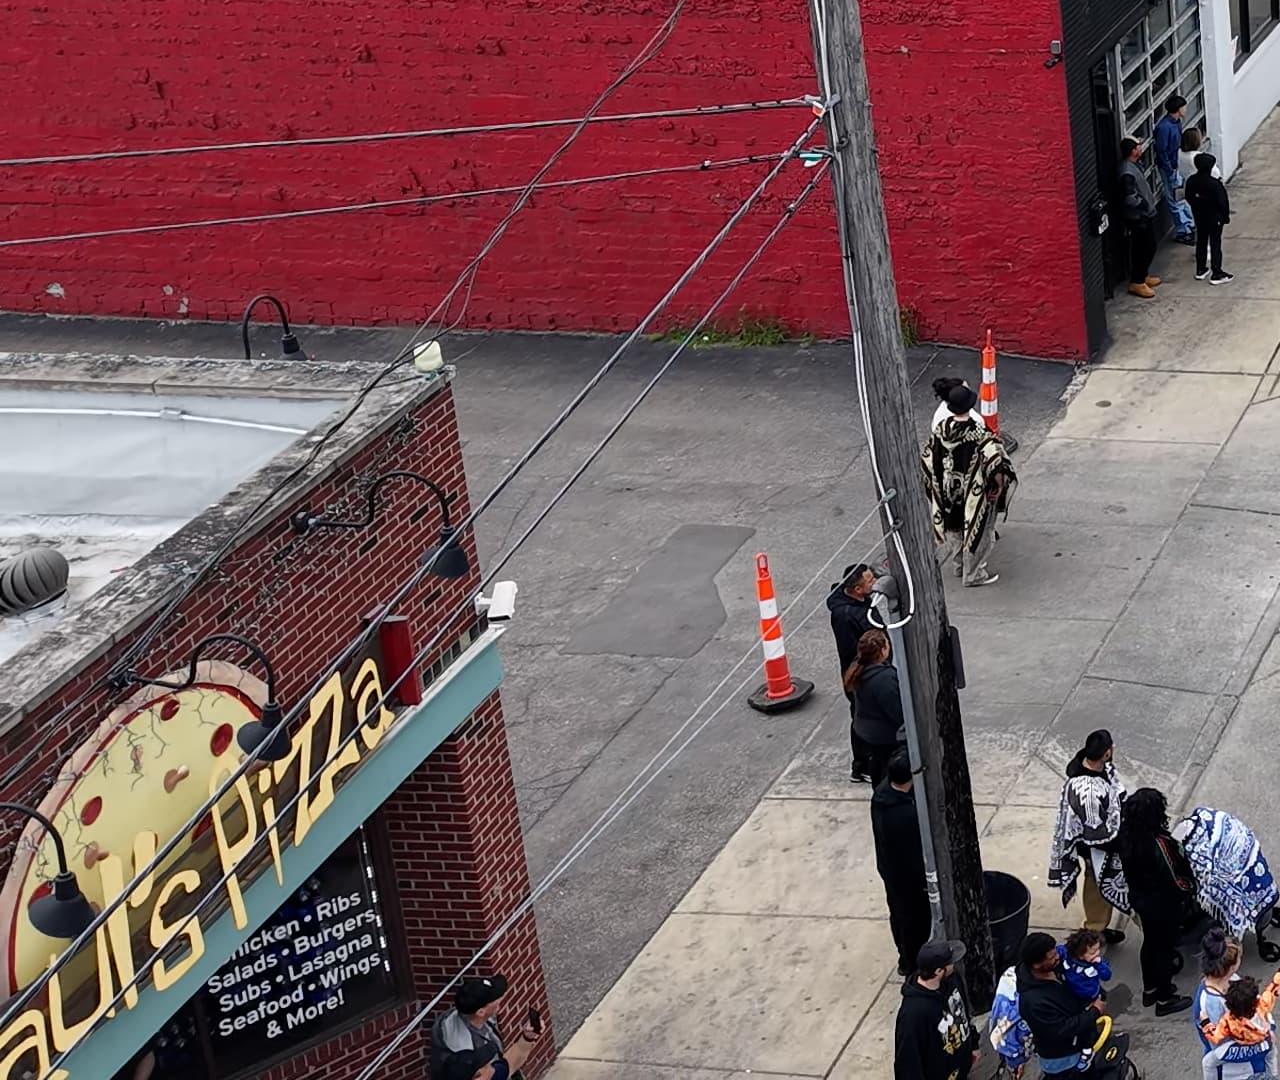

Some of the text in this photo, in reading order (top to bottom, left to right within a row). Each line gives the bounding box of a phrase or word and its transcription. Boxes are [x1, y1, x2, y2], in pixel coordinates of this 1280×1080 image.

[316, 892, 361, 921] Ribs
[0, 830, 206, 1080] aul's
[207, 908, 376, 994] Salads Burgers
[219, 934, 373, 1012] Subs Lasagna
[218, 952, 381, 1036] Seafood Wings
[266, 988, 345, 1039] & More!
